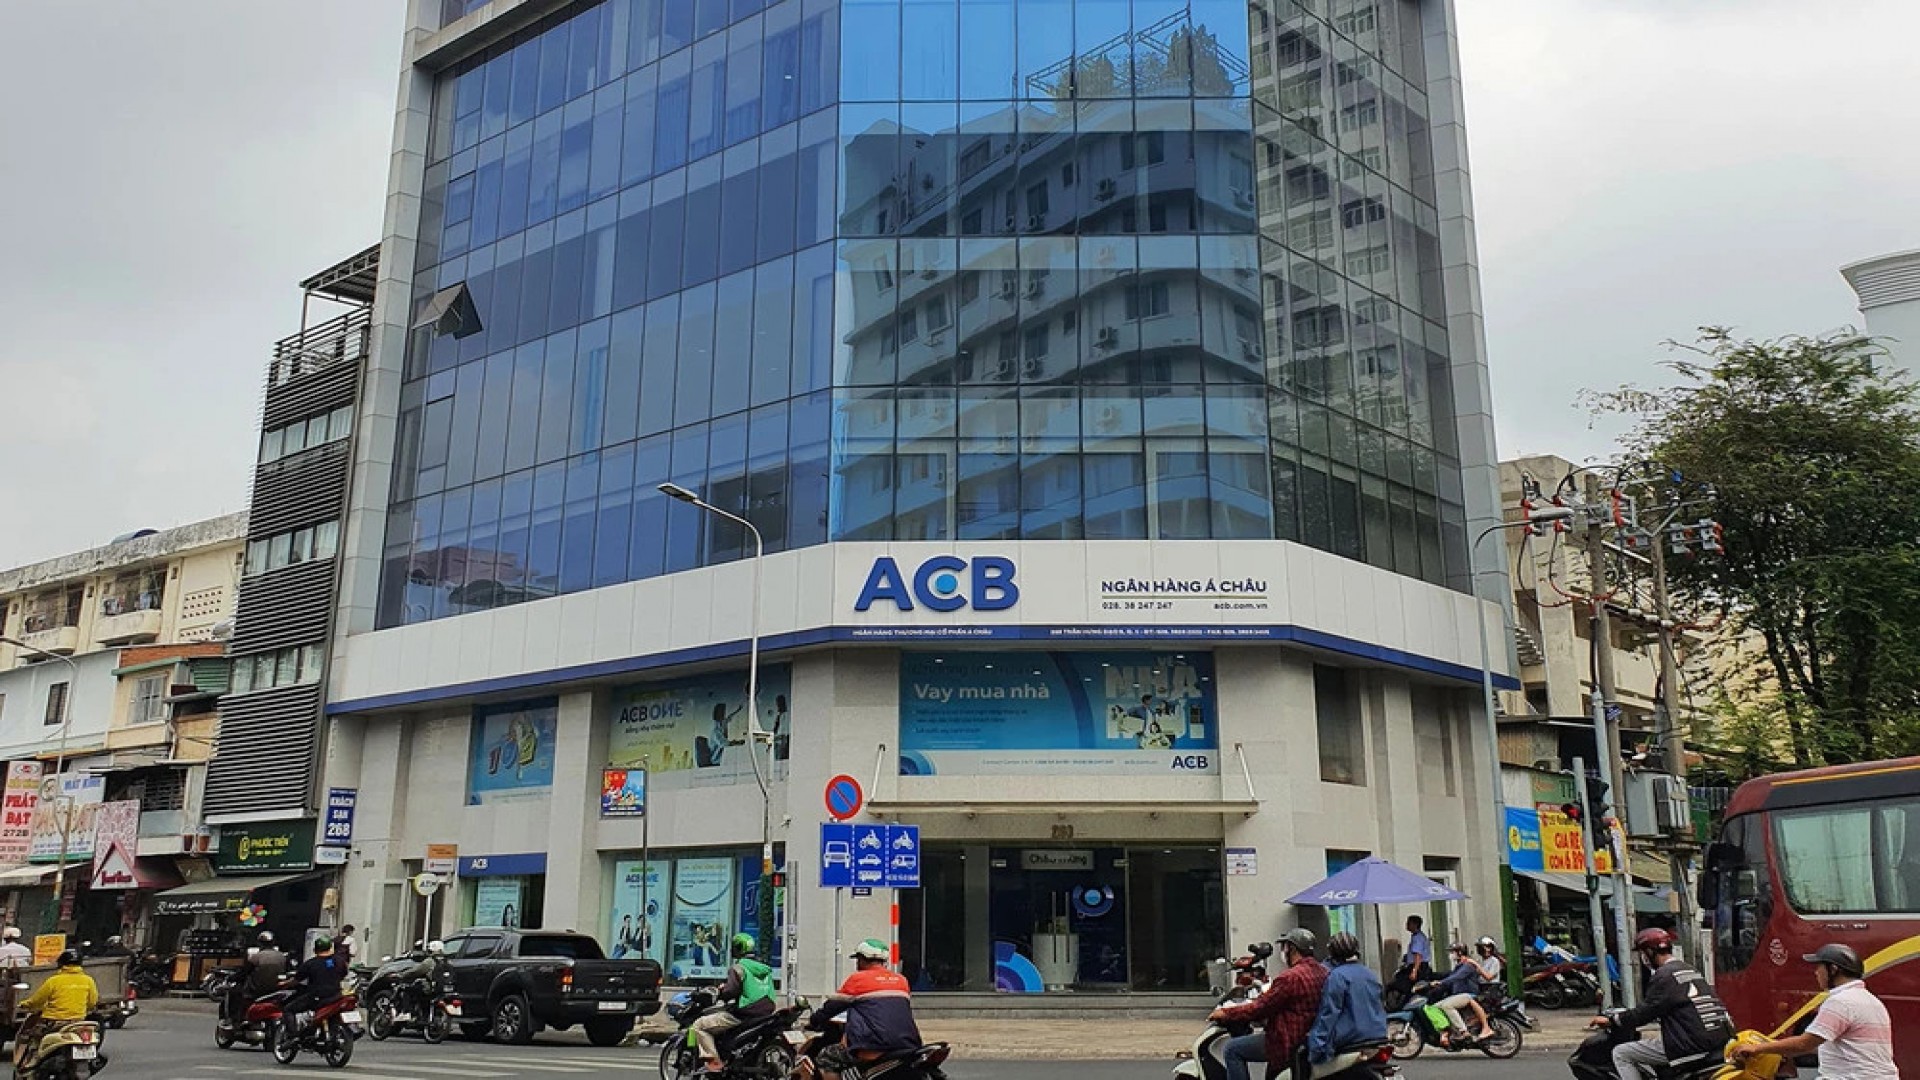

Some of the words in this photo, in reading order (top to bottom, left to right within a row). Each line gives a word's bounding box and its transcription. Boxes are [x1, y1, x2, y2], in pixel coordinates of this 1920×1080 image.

[854, 555, 1020, 612] ACB
[1101, 579, 1149, 592] NGÂN
[1153, 578, 1201, 592] HÀNG
[1205, 578, 1216, 592] Á
[1220, 578, 1267, 592] CHÂU
[914, 683, 953, 702] Vay
[960, 686, 1005, 698] mua
[1011, 682, 1050, 698] nhà
[619, 706, 648, 724] ACB
[1171, 755, 1209, 769] ACB
[5, 792, 38, 808] PHÁT
[327, 822, 351, 837] 268
[471, 858, 489, 870] ACB
[1319, 889, 1359, 899] ACB
